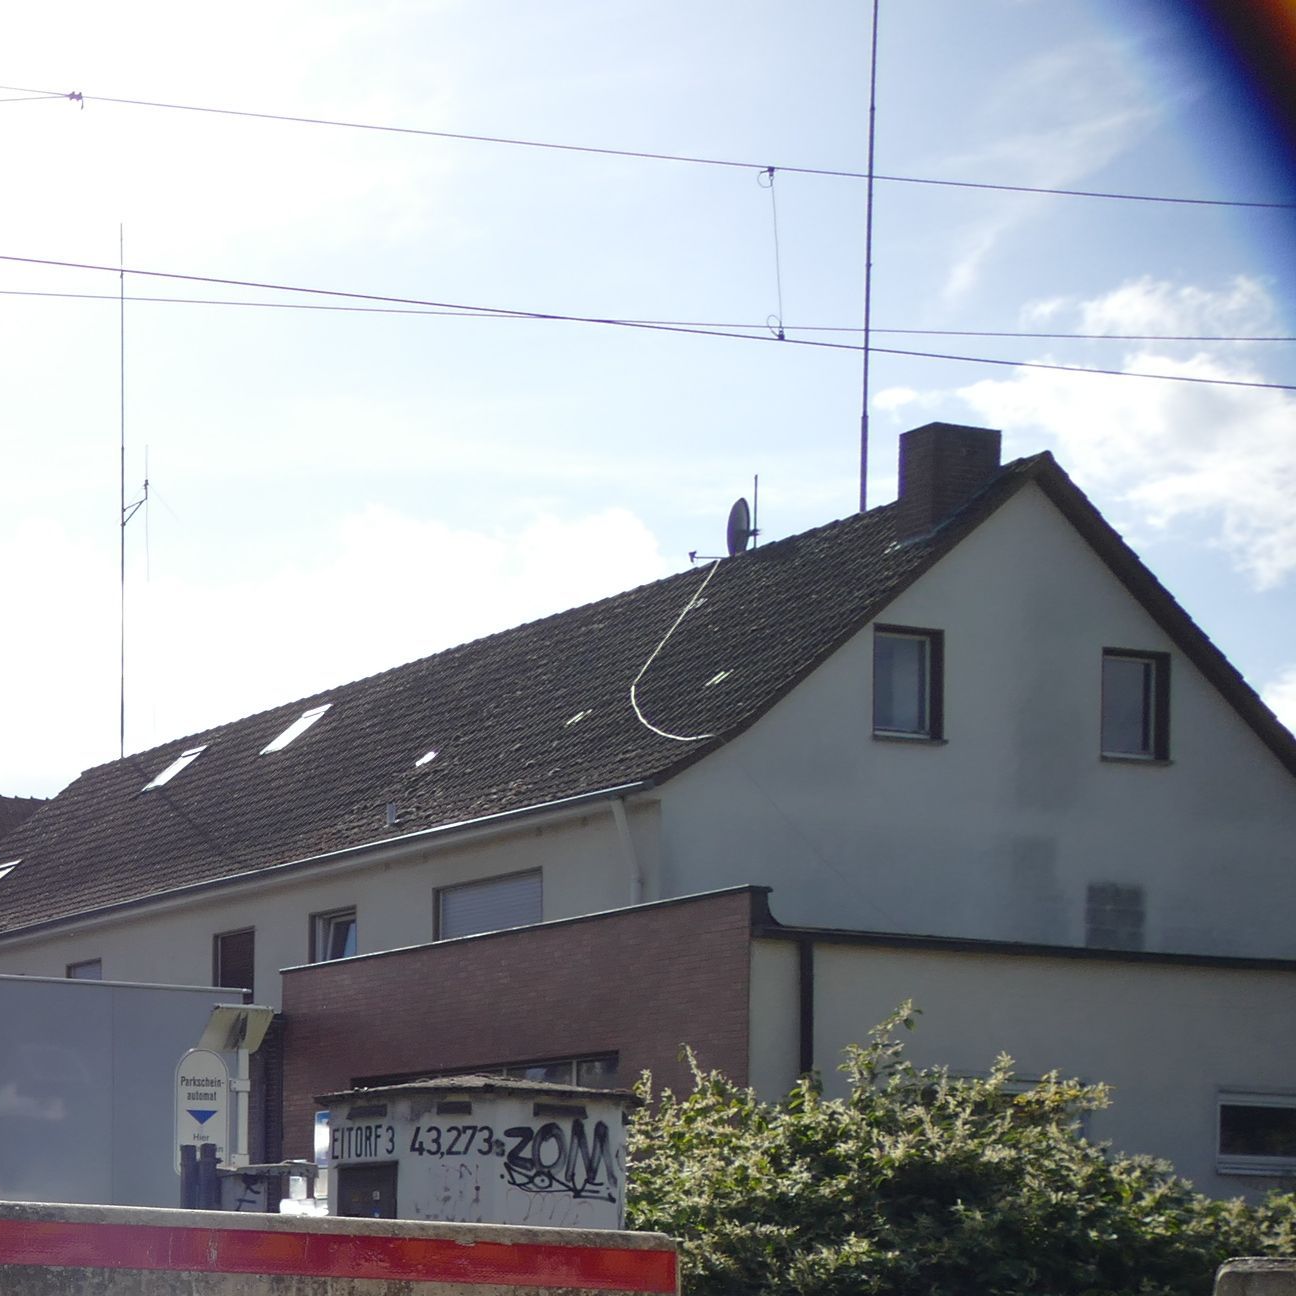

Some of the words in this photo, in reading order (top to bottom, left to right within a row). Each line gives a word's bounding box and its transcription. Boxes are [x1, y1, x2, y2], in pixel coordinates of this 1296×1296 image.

[180, 1075, 225, 1088] Parkschein-
[186, 1090, 217, 1101] automat
[192, 1132, 210, 1142] Hier
[331, 1126, 381, 1160] EITORF
[386, 1124, 396, 1155] 3
[409, 1125, 494, 1160] 43,273
